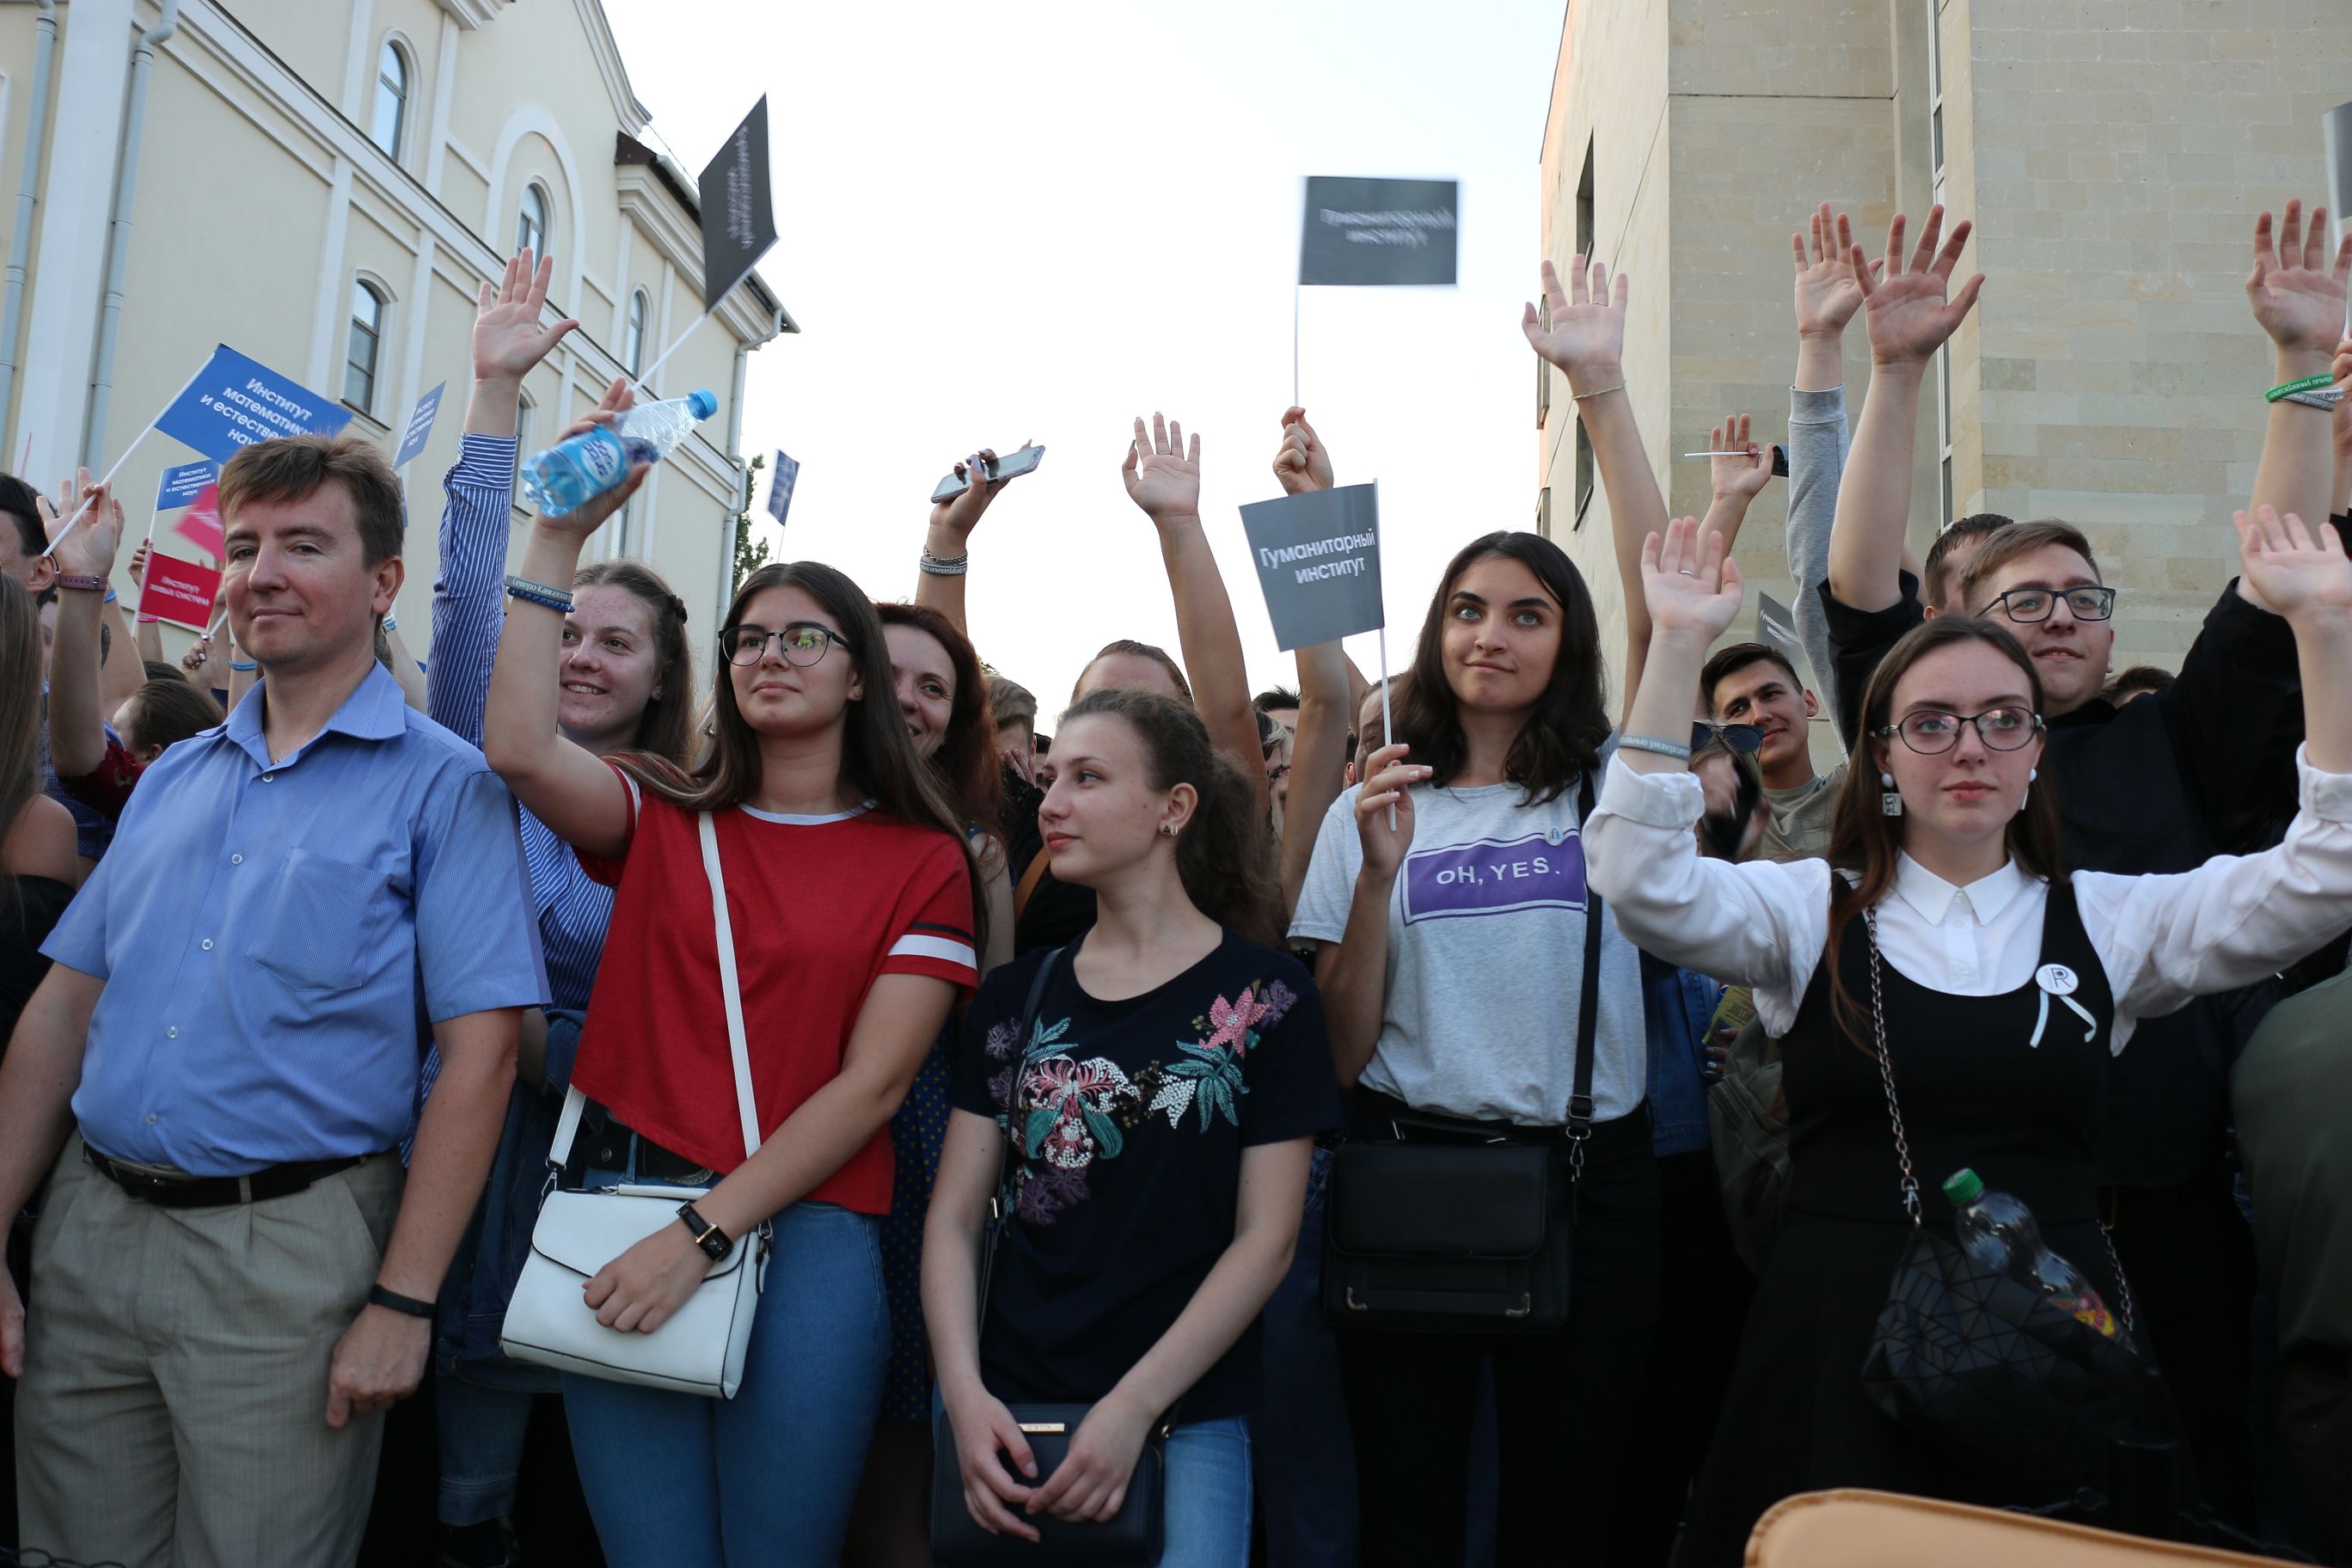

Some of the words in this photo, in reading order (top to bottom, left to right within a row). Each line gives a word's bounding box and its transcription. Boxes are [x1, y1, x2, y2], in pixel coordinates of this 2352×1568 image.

[200, 395, 214, 406] и
[246, 378, 313, 421] Институт
[172, 473, 211, 485] математики
[179, 467, 207, 478] Институт
[1259, 528, 1375, 569] Гуманитарный
[1295, 557, 1365, 584] институт
[1436, 865, 1484, 885] OH,
[1489, 856, 1560, 881] YES.
